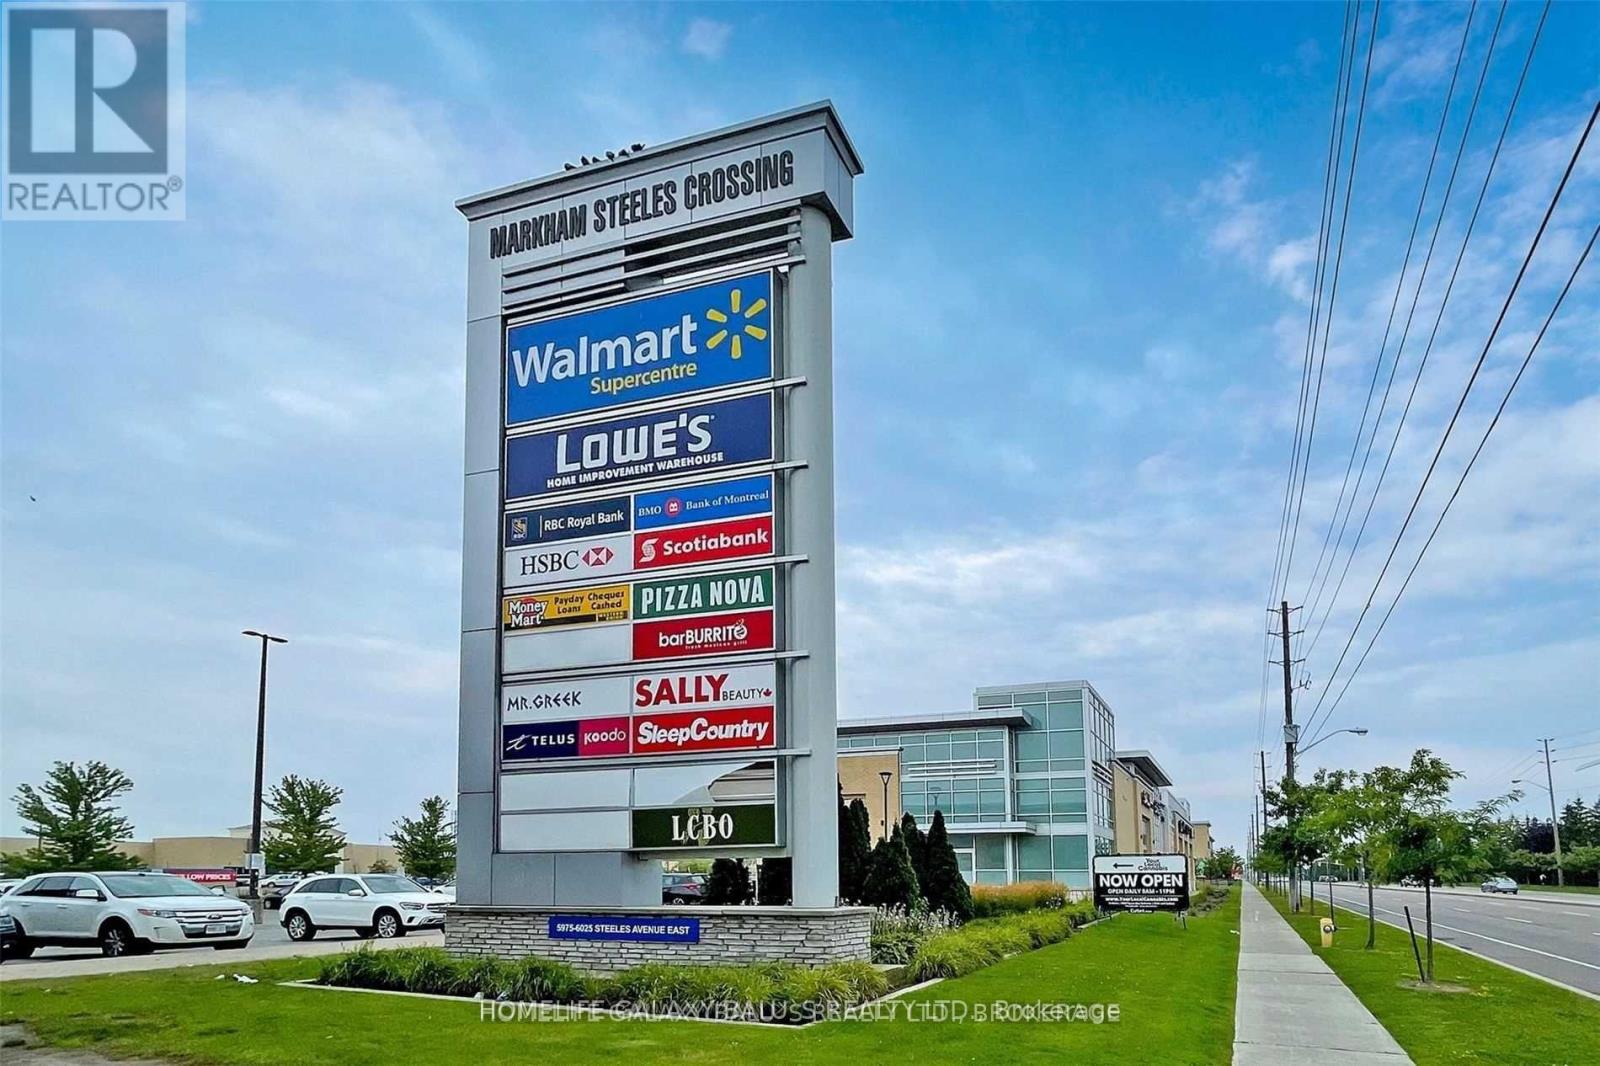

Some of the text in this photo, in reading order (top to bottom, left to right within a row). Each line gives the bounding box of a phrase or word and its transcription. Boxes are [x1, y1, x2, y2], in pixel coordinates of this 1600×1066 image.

[490, 150, 794, 259] MARKHAM STEELES CROSSING
[511, 314, 698, 387] Walmart
[590, 362, 698, 395] Supercentre
[556, 413, 713, 474] LOWE'S
[547, 451, 724, 489] HOME IMPROVEMENT WAREHOUSE
[638, 489, 769, 517] BMO Bank of Montreal
[544, 509, 625, 532] RBC Royal Bank
[663, 528, 769, 556] Scotiabank
[520, 549, 580, 576] HSBC
[508, 600, 548, 615] Money
[554, 590, 625, 606] Payday Cheques
[557, 600, 622, 615] Loans Cashed
[641, 575, 765, 615] PIZZA NOVA
[510, 613, 542, 628] Mart
[635, 673, 764, 707] SALLY BEAUTY
[531, 733, 576, 746] TELUS
[671, 813, 734, 841] LCBO
[1099, 874, 1184, 888] NOW OPEN
[556, 923, 690, 935] 5975-6025 STEELES AVENUE EAST
